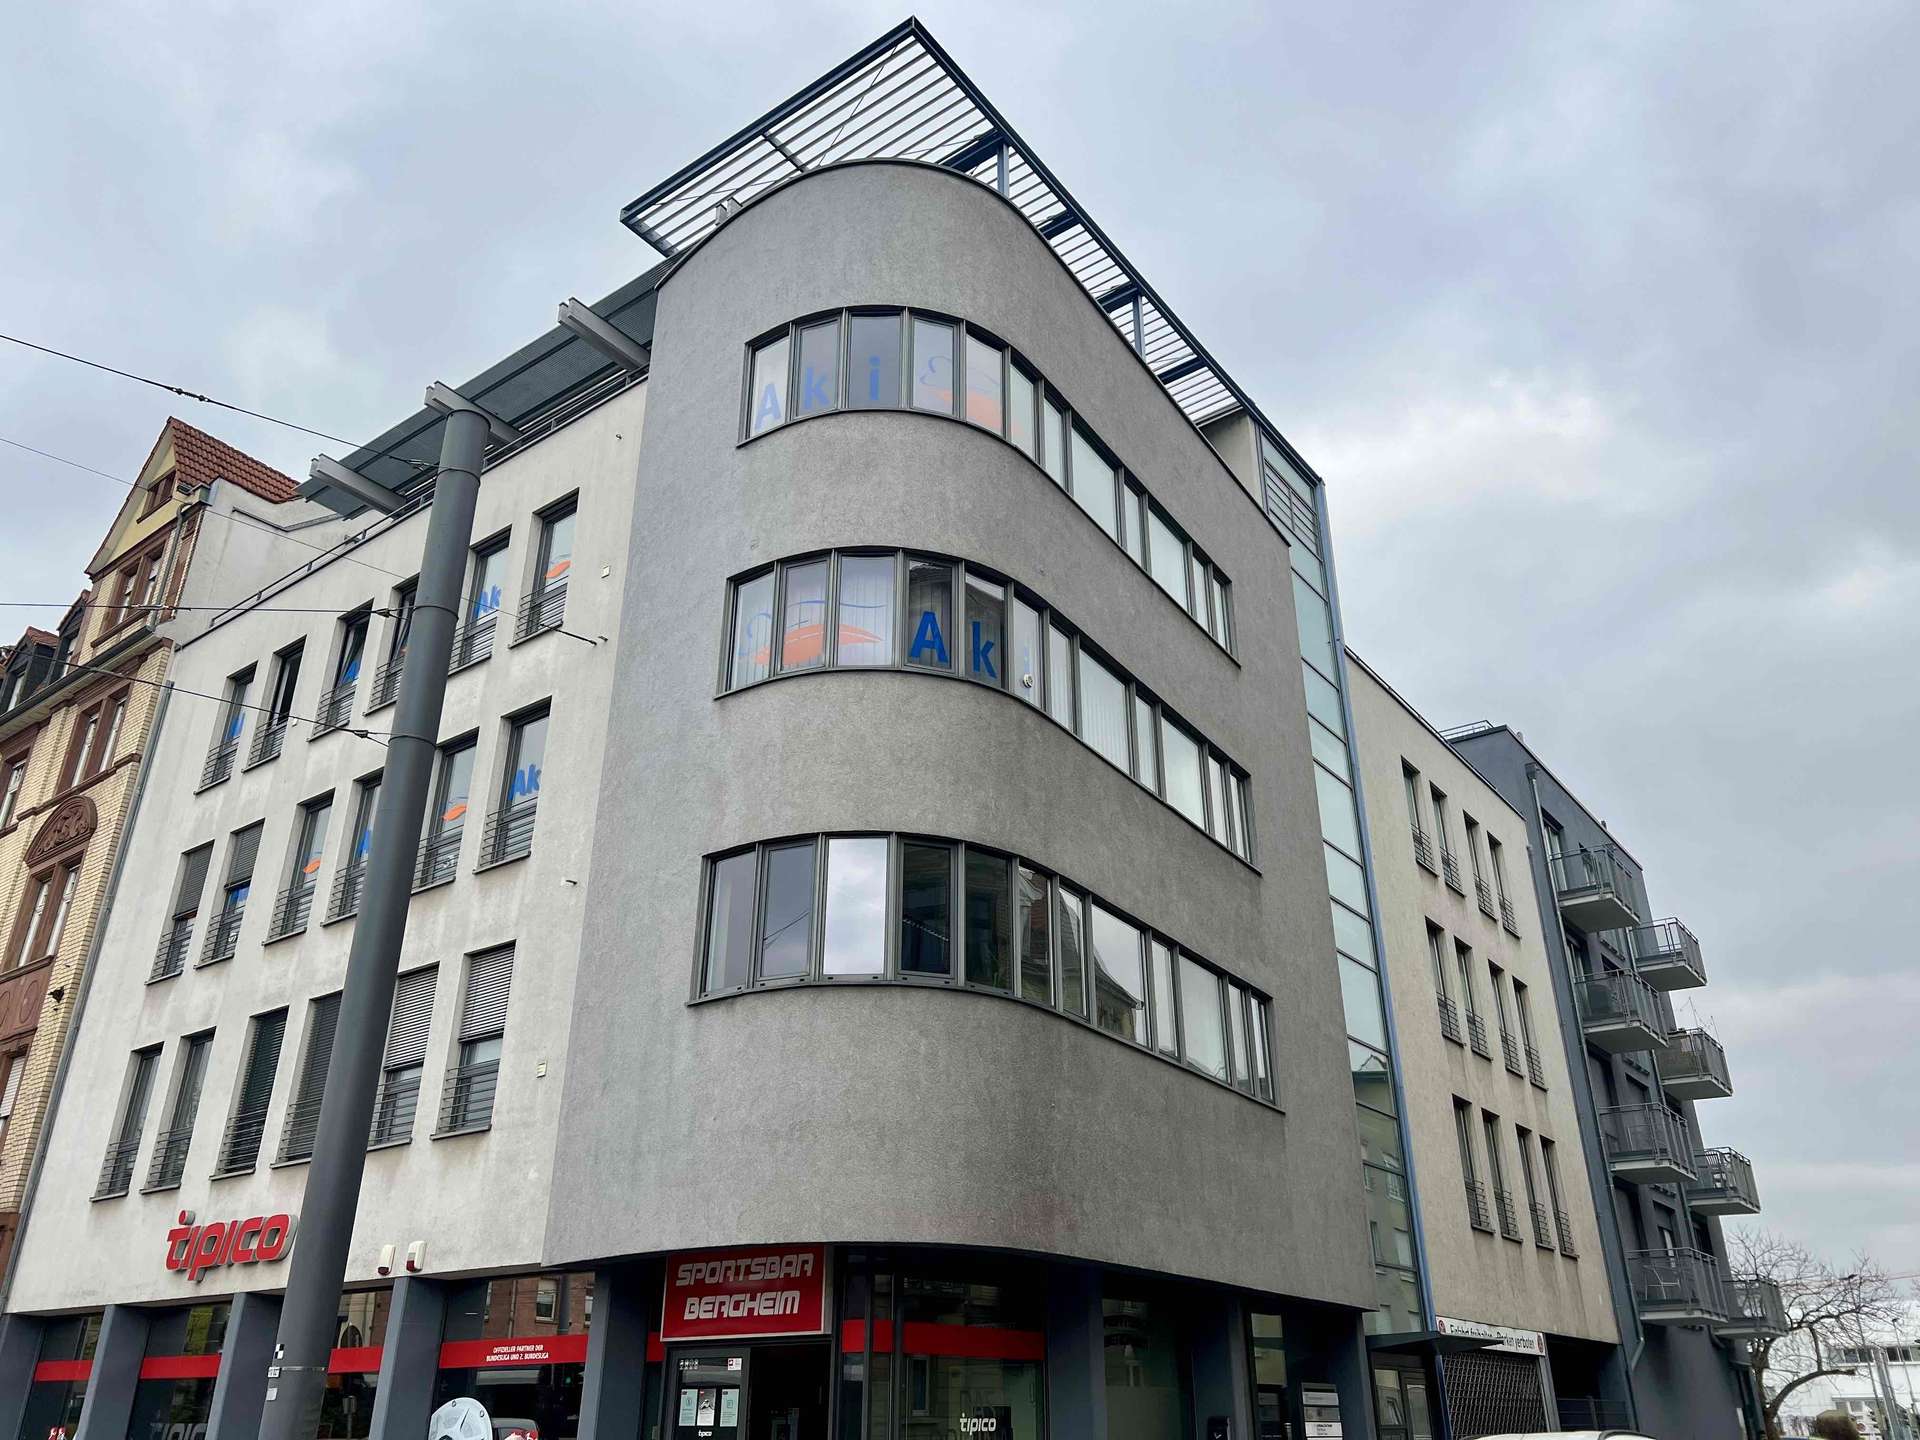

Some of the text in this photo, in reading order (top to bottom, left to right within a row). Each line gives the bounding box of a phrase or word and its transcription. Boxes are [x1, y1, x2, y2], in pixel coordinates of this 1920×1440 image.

[166, 1209, 294, 1281] tipico
[676, 1253, 814, 1286] SPORTSBAR
[684, 1290, 800, 1320] BERGHEIM
[959, 1412, 996, 1436] tipico
